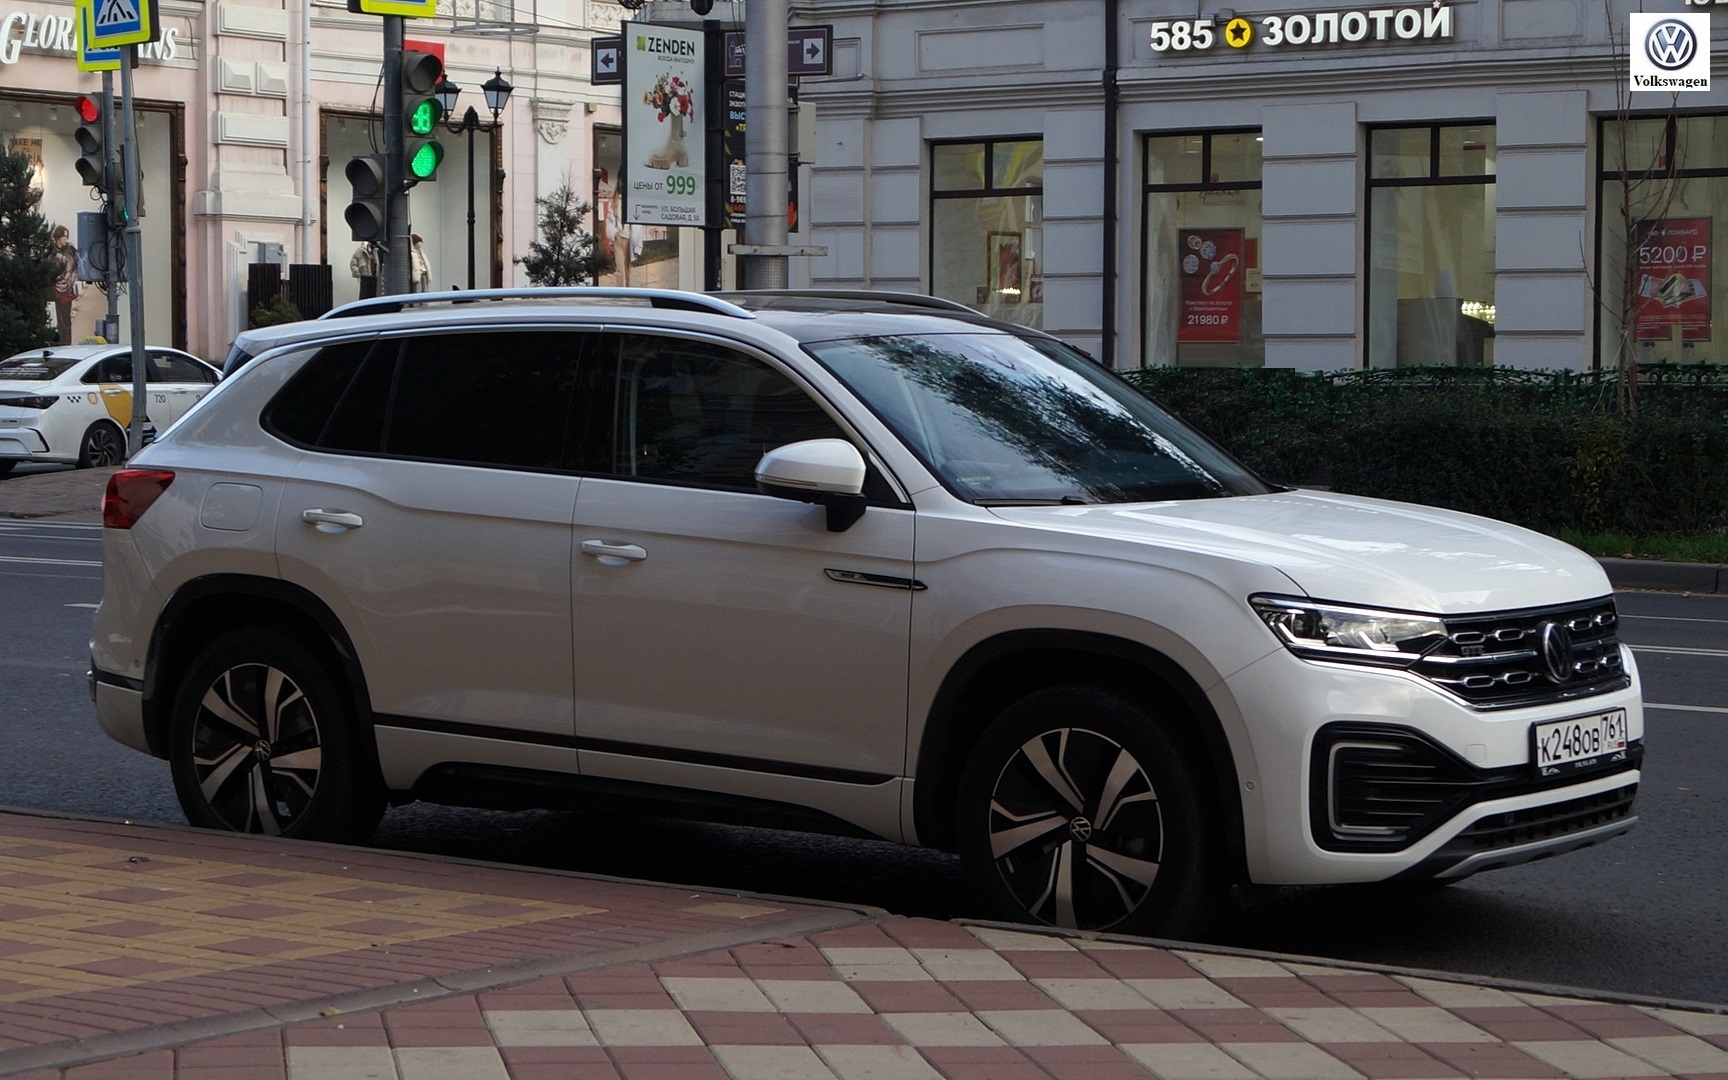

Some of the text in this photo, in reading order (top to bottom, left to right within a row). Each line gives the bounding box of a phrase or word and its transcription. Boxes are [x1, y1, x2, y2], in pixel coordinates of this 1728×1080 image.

[1150, 1, 1454, 52] 585 ЗОЛОТОЙ
[648, 36, 695, 56] ZENDEN
[633, 175, 696, 196] ЦЕНЫ ОТ 999
[1640, 245, 1688, 264] 5200
[1188, 315, 1220, 325] 21980
[154, 394, 167, 403] 720
